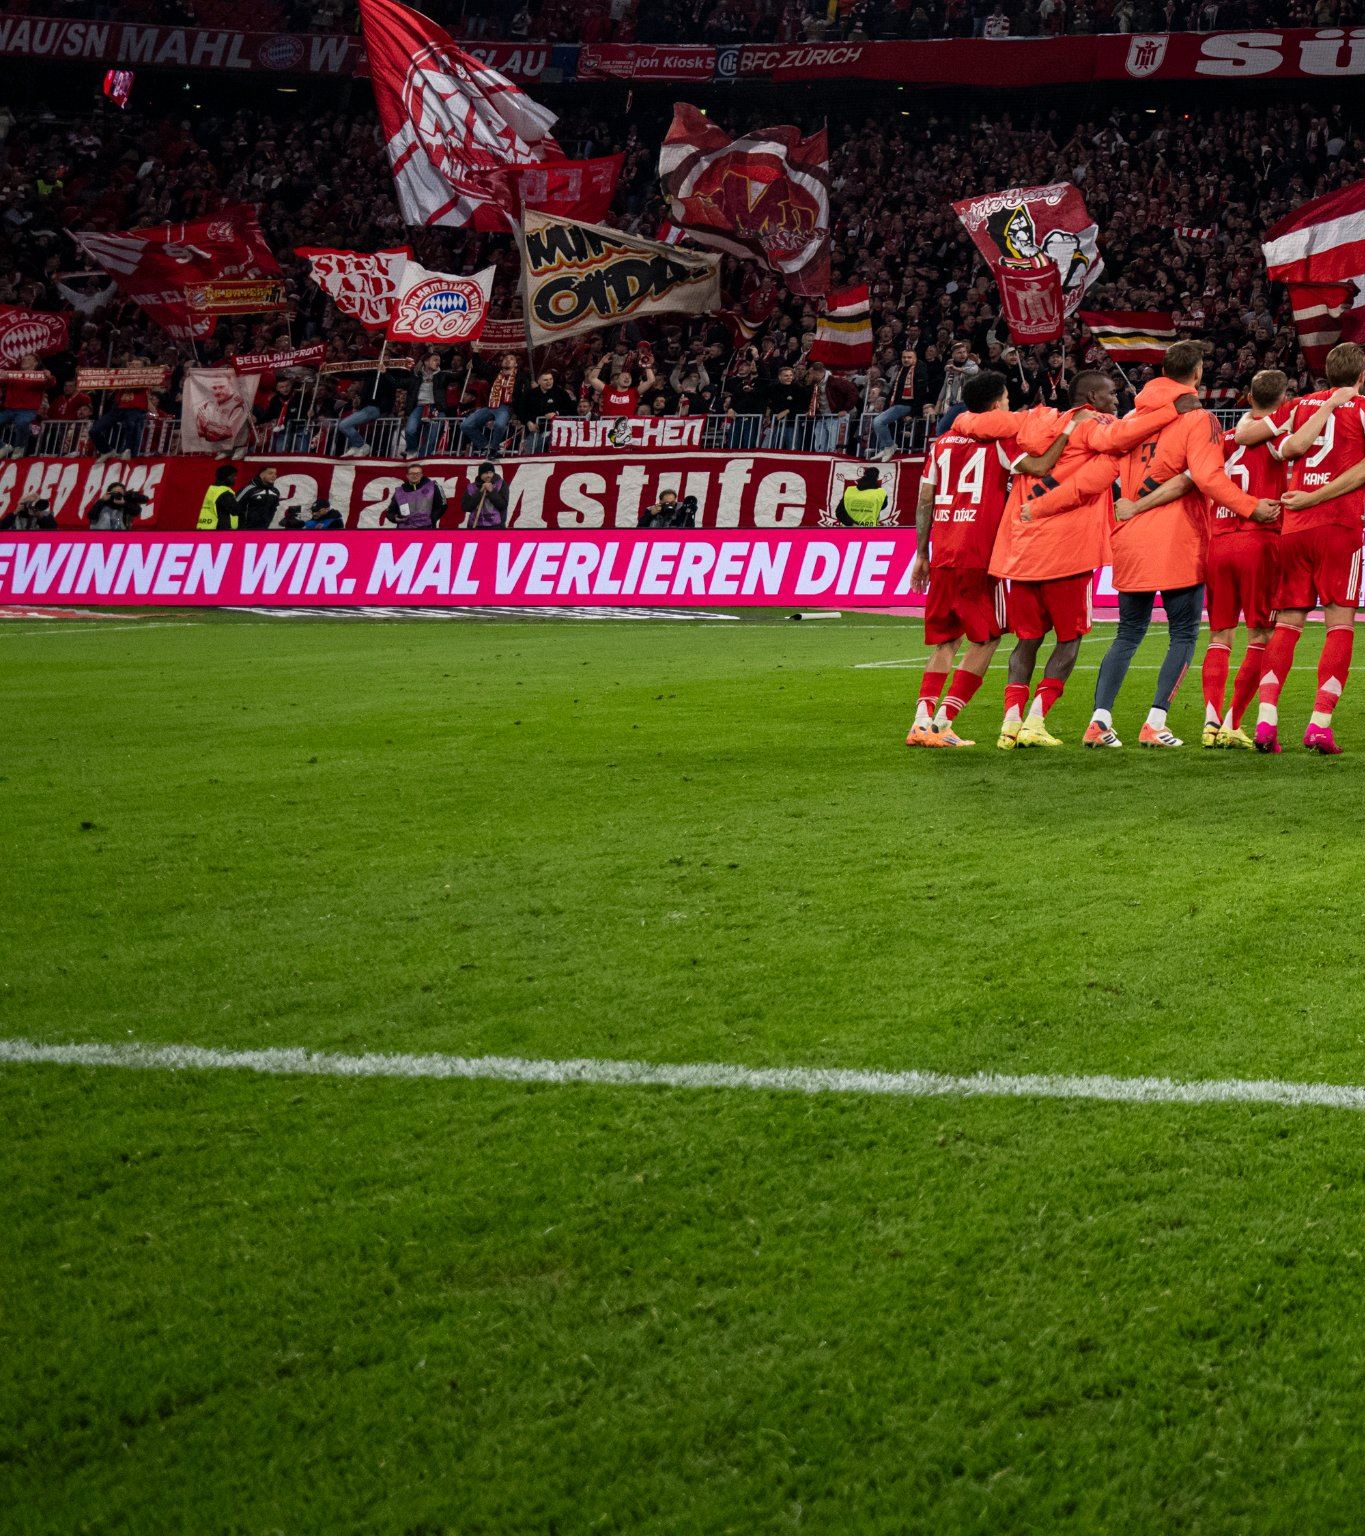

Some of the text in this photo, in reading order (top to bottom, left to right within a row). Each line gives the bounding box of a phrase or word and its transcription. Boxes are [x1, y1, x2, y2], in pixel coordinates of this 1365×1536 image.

[118, 26, 252, 68] MAHL
[664, 56, 704, 69] Kiosk
[740, 47, 863, 72] BFC ZÜRICH
[1306, 413, 1336, 468] 9
[935, 447, 987, 505] 14
[1303, 472, 1331, 485] KANE
[953, 507, 977, 522] DÍAZ
[239, 542, 356, 595] WIR.
[367, 542, 481, 595] MAL
[495, 541, 791, 595] VERLIEREN
[795, 541, 896, 595] DIE
